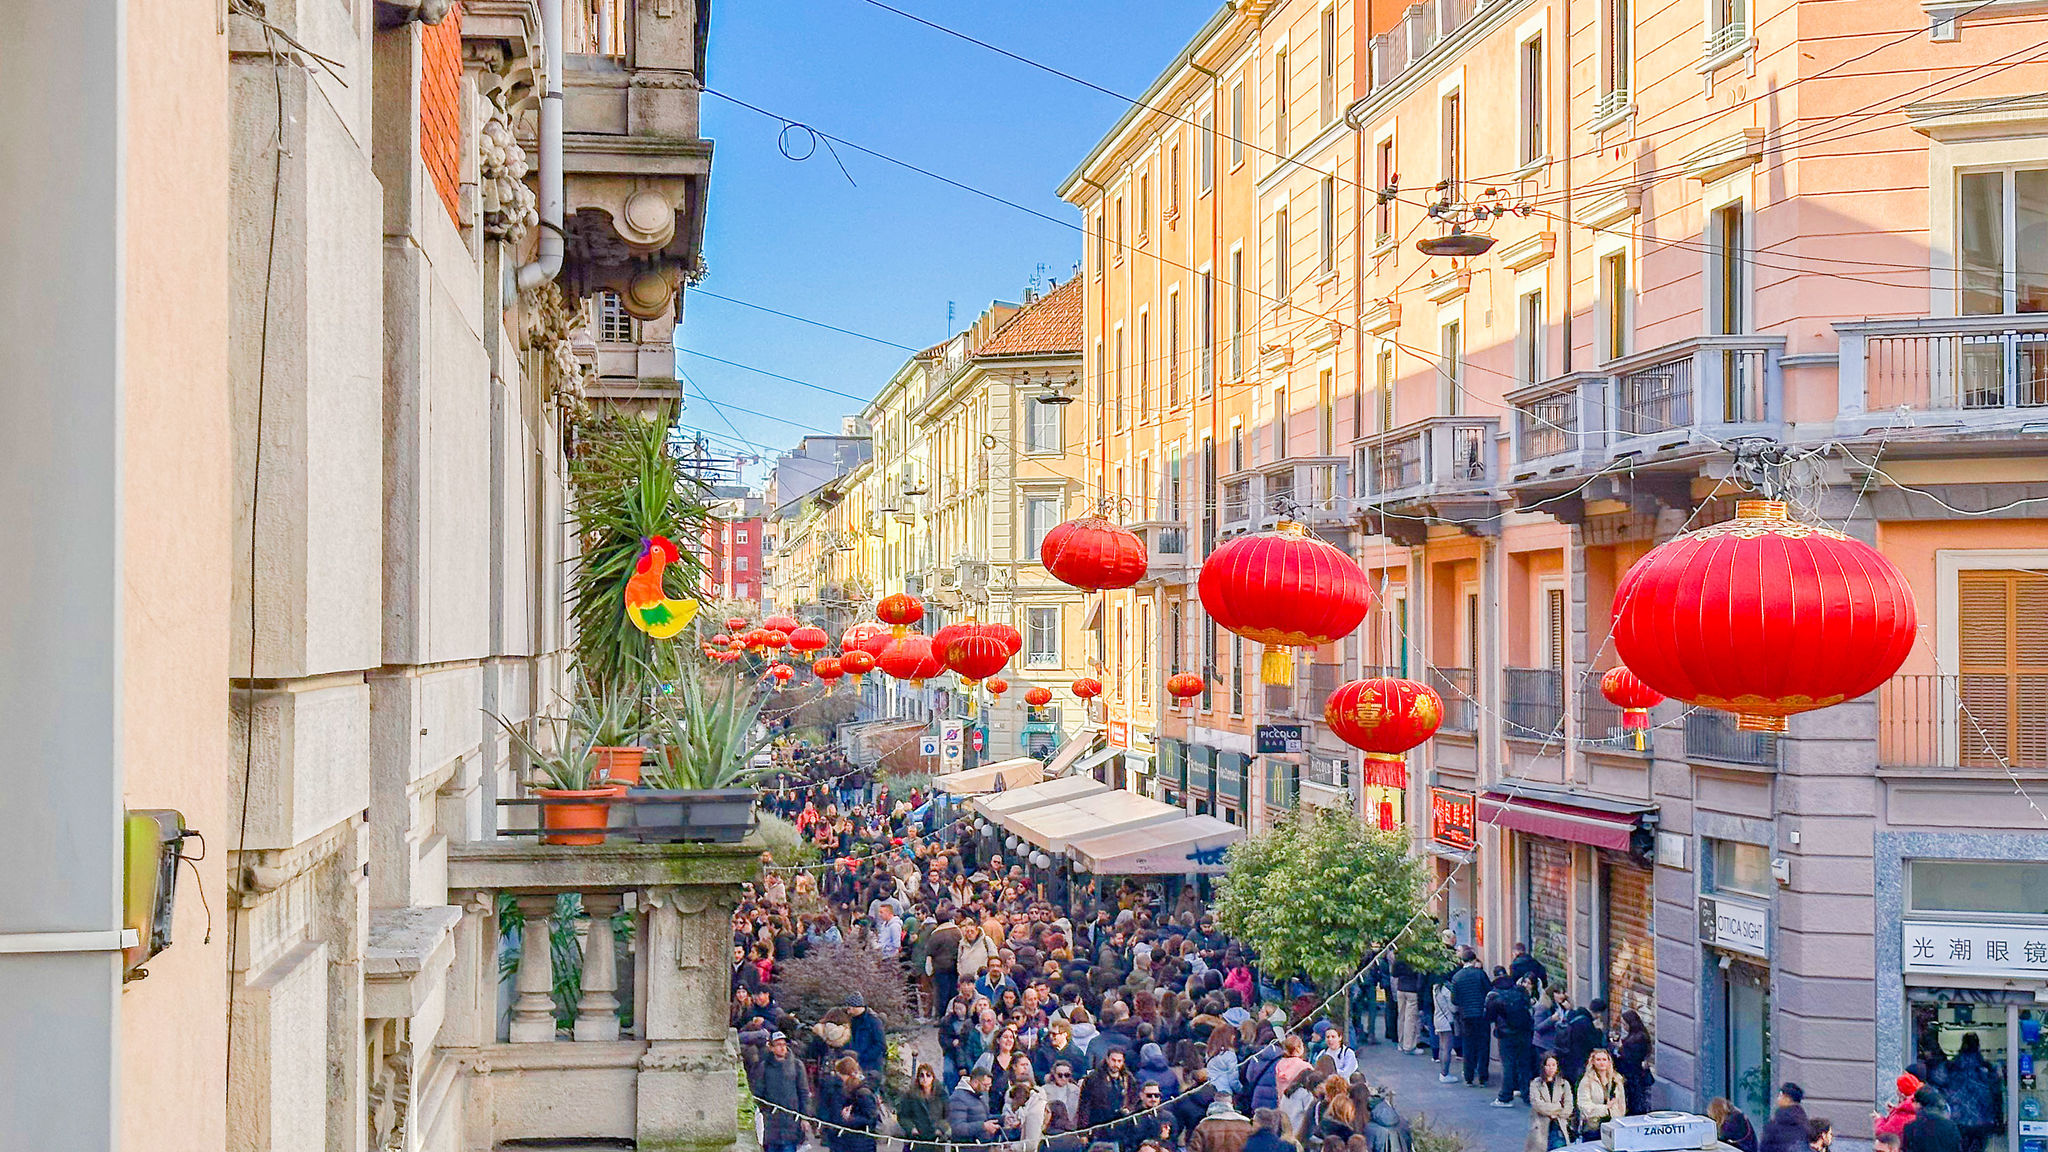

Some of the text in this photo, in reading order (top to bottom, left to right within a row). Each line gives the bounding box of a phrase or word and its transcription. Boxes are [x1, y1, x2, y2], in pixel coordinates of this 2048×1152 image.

[1260, 730, 1298, 739] PICCOLO
[1717, 915, 1763, 941] OTTICA SIGHT
[1912, 936, 2048, 963] 光潮眼镜
[1644, 1124, 1686, 1136] ZANOTTI
